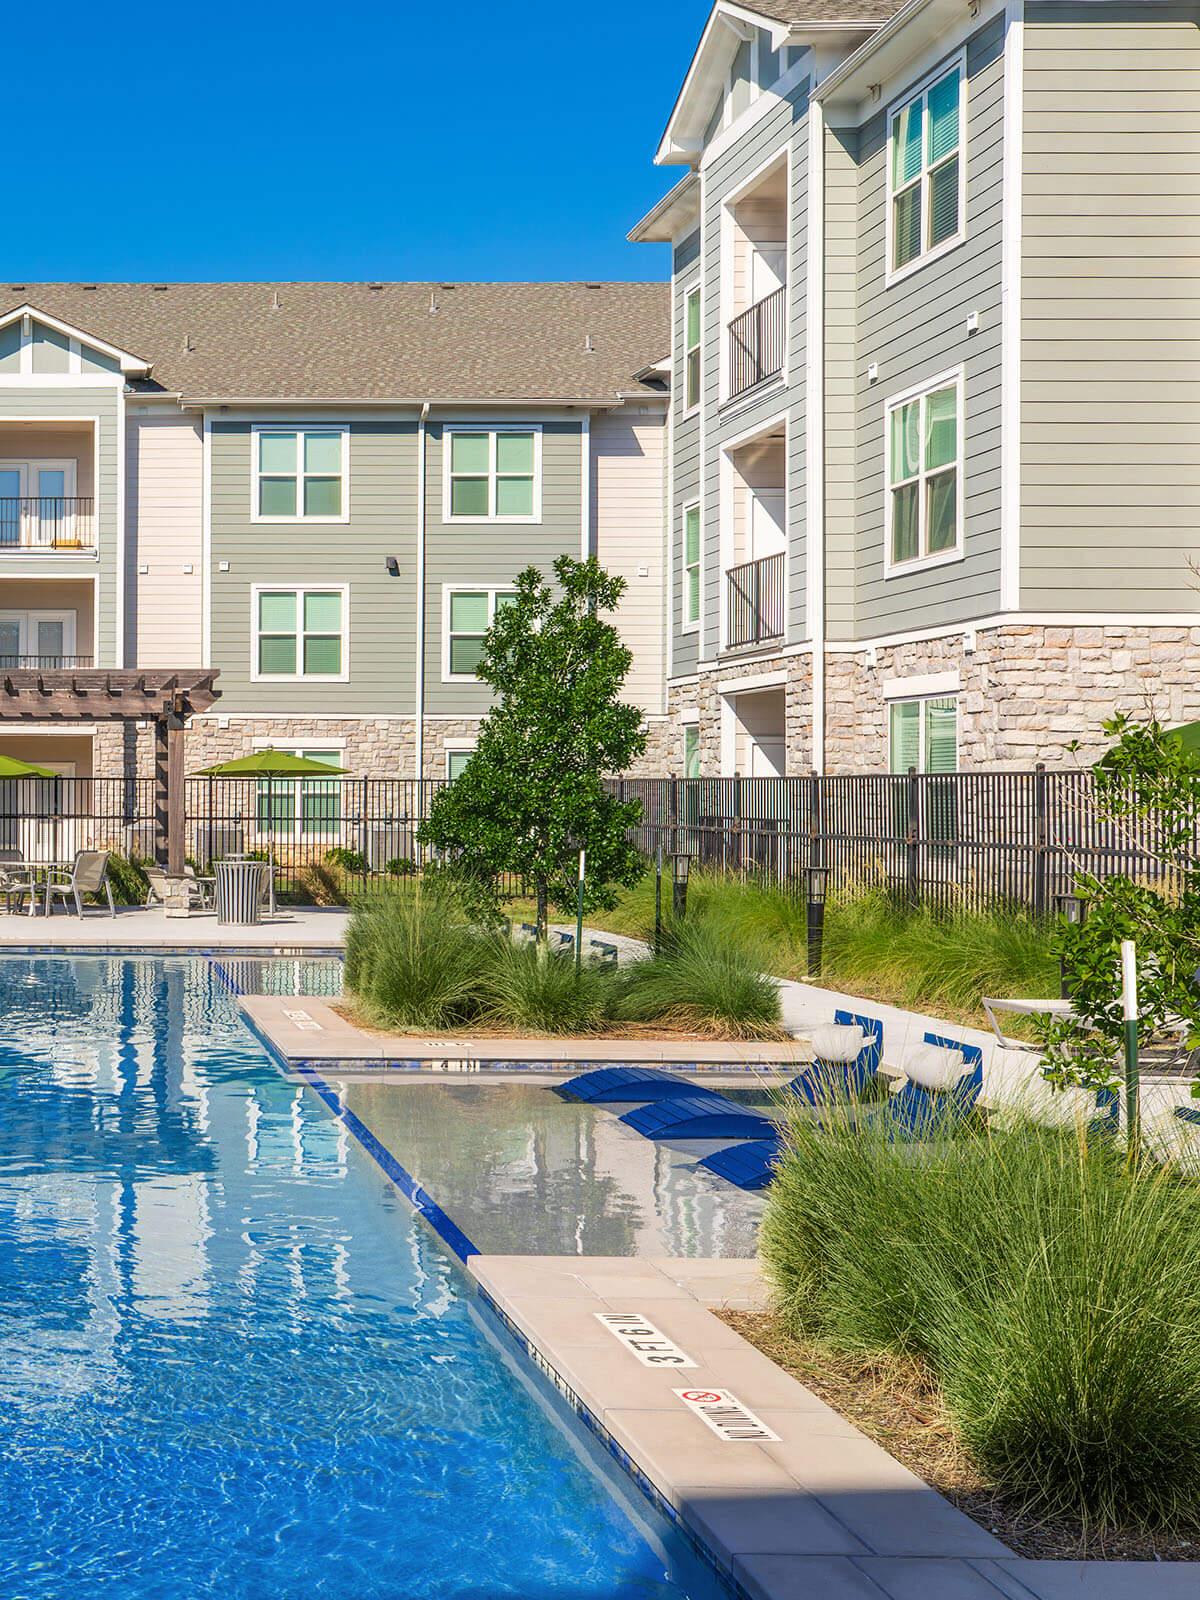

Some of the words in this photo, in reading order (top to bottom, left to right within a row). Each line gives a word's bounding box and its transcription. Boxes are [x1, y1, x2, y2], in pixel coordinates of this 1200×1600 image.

[602, 1315, 644, 1325] IN
[618, 1328, 654, 1336] 6
[628, 1339, 673, 1352] FT
[647, 1355, 685, 1364] 3
[699, 1406, 758, 1428] DIVING
[724, 1429, 772, 1440] NO
